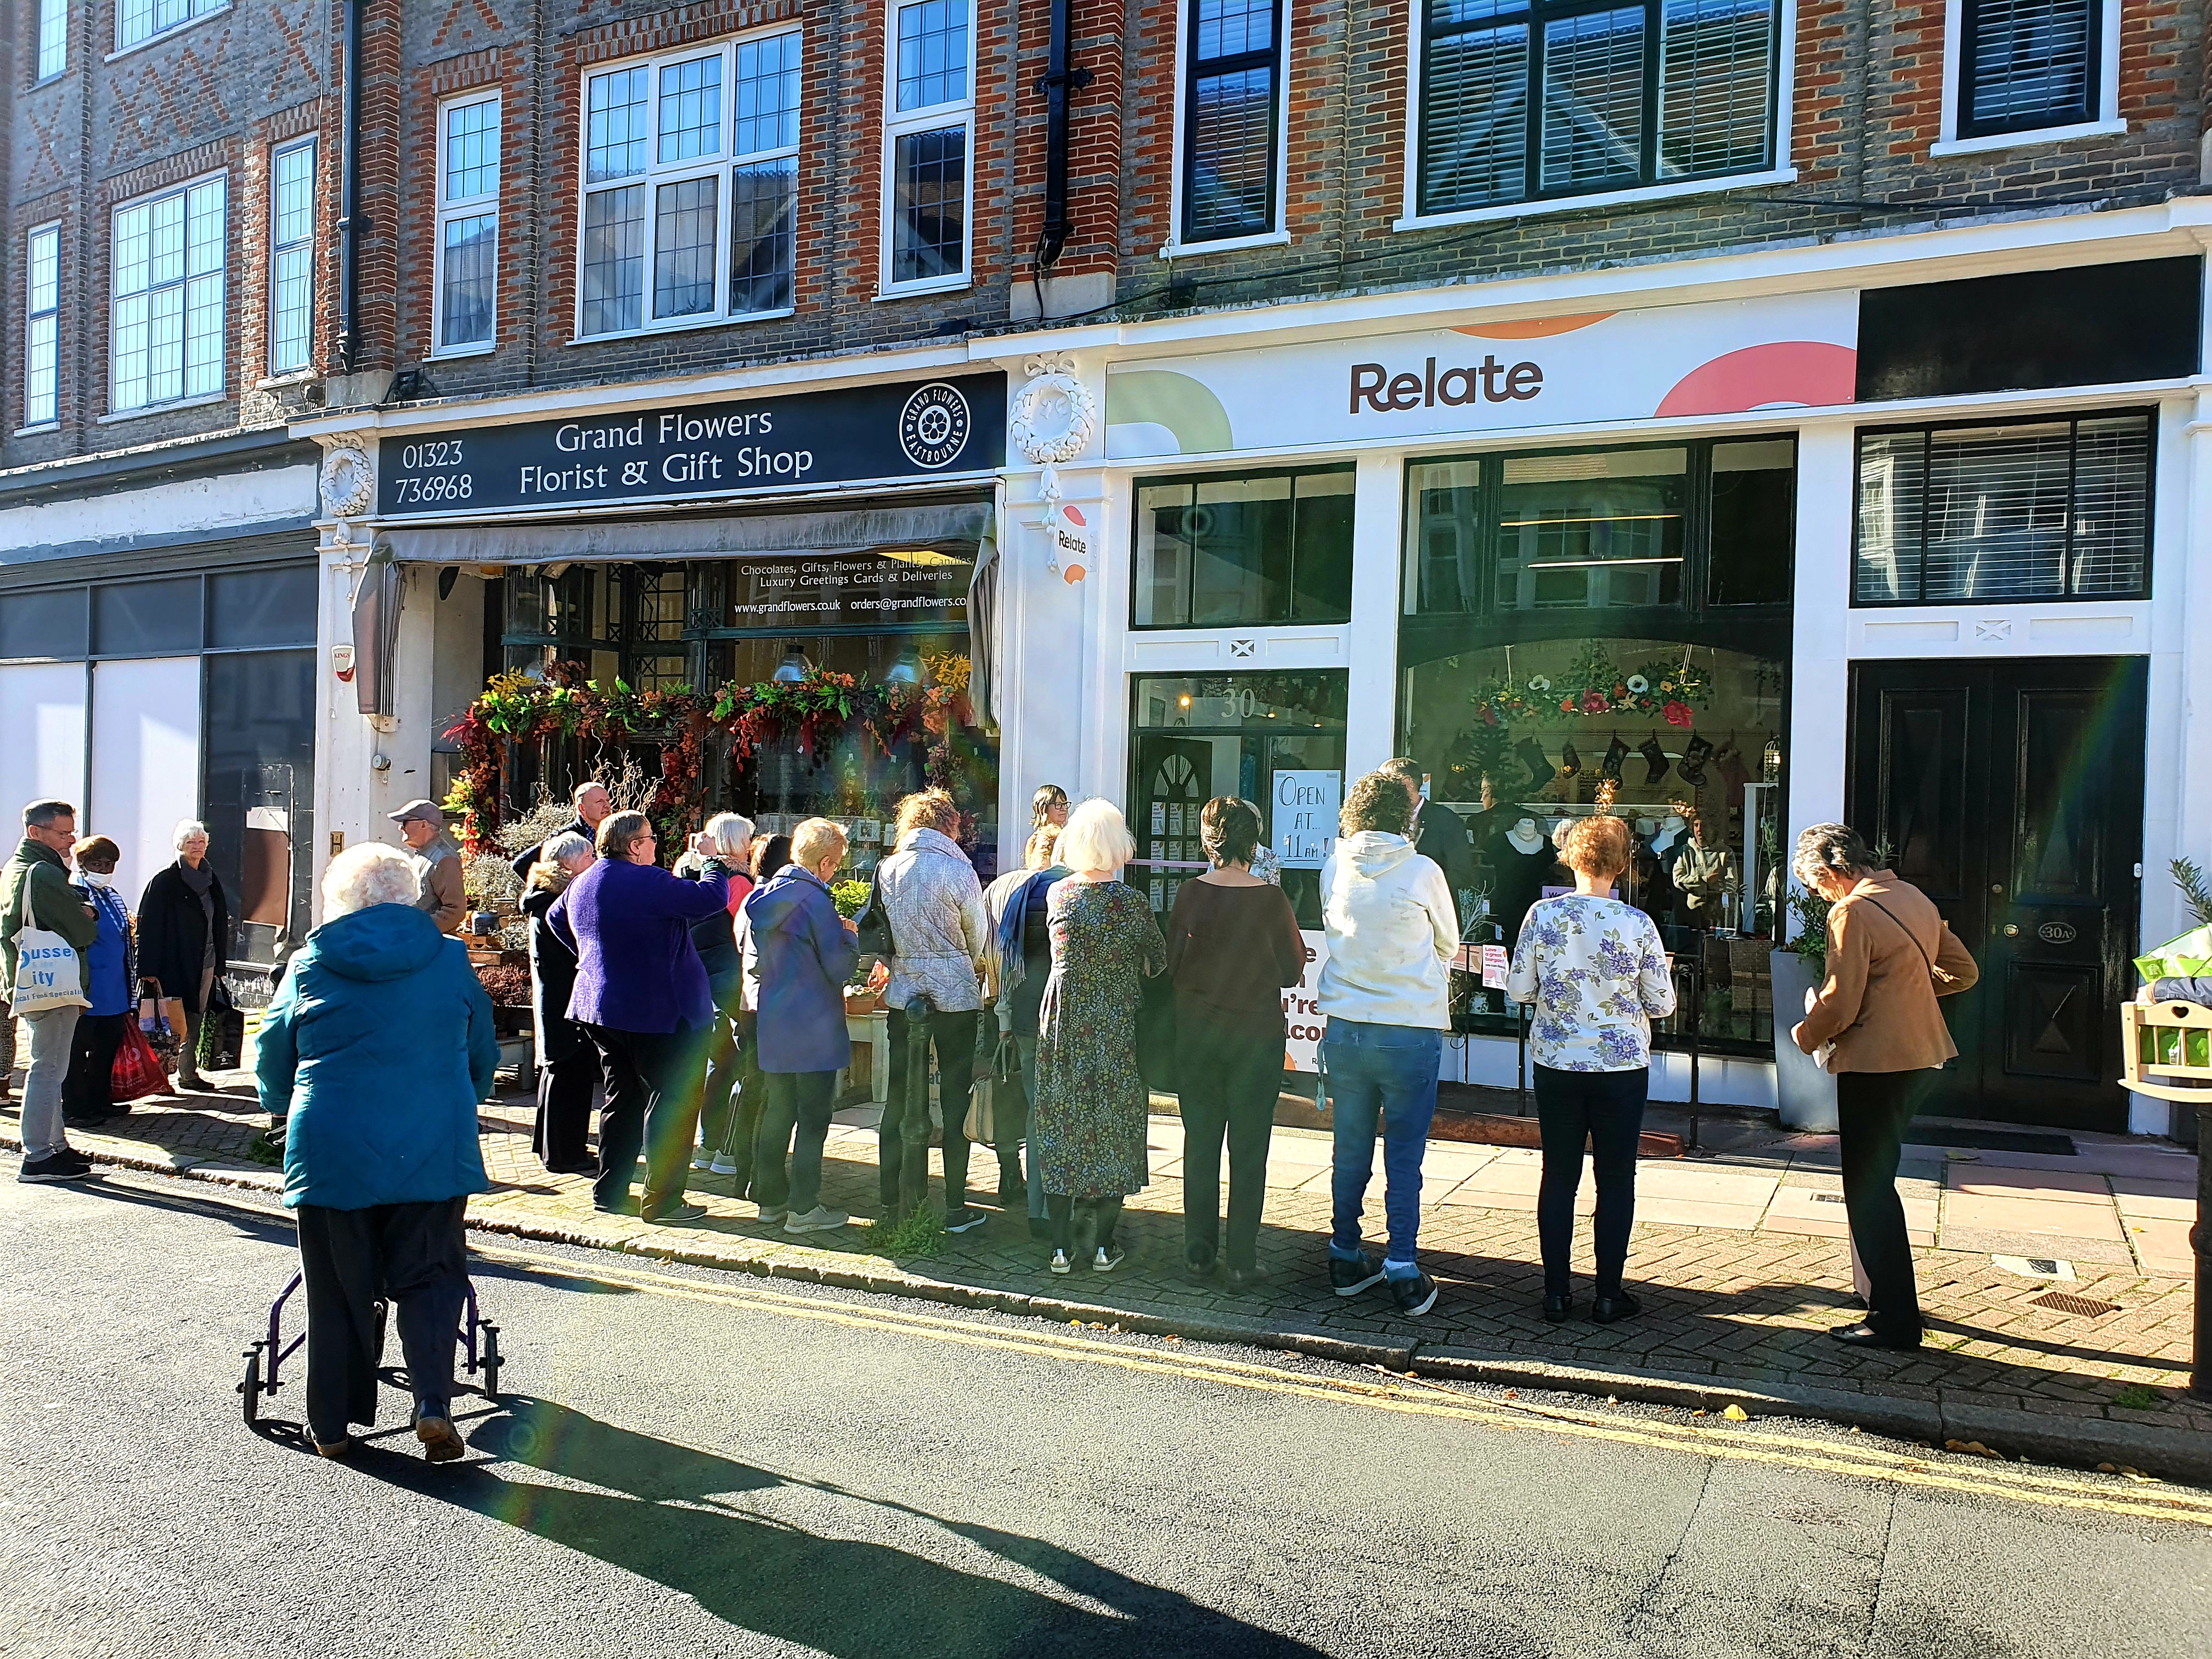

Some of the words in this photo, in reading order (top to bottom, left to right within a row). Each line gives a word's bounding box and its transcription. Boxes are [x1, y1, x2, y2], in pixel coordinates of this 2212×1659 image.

[1350, 354, 1544, 414] Relate
[907, 393, 929, 421] GRAND
[933, 389, 963, 417] FLOWERS
[555, 417, 643, 452] Grand
[659, 412, 772, 443] Flowers
[906, 430, 963, 462] EASTBOURNE
[402, 439, 463, 470] 01323
[520, 464, 608, 494] Florist
[621, 461, 648, 486] &
[662, 451, 723, 482] Gift
[737, 446, 813, 478] Shop
[395, 473, 473, 504] 736968
[1059, 529, 1086, 554] Relate
[741, 564, 797, 575] Chocolates,
[802, 562, 830, 573] Gifts,
[834, 561, 872, 572] Flowers
[877, 561, 887, 569] &
[760, 577, 795, 588] Luxury
[800, 575, 849, 585] Greetings
[854, 572, 884, 583] Cards
[888, 573, 898, 582] &
[902, 571, 953, 582] Deliveries
[735, 599, 841, 614] www.grandflowers.co.uk
[1221, 688, 1255, 718] 30
[1278, 776, 1325, 806] OPEN
